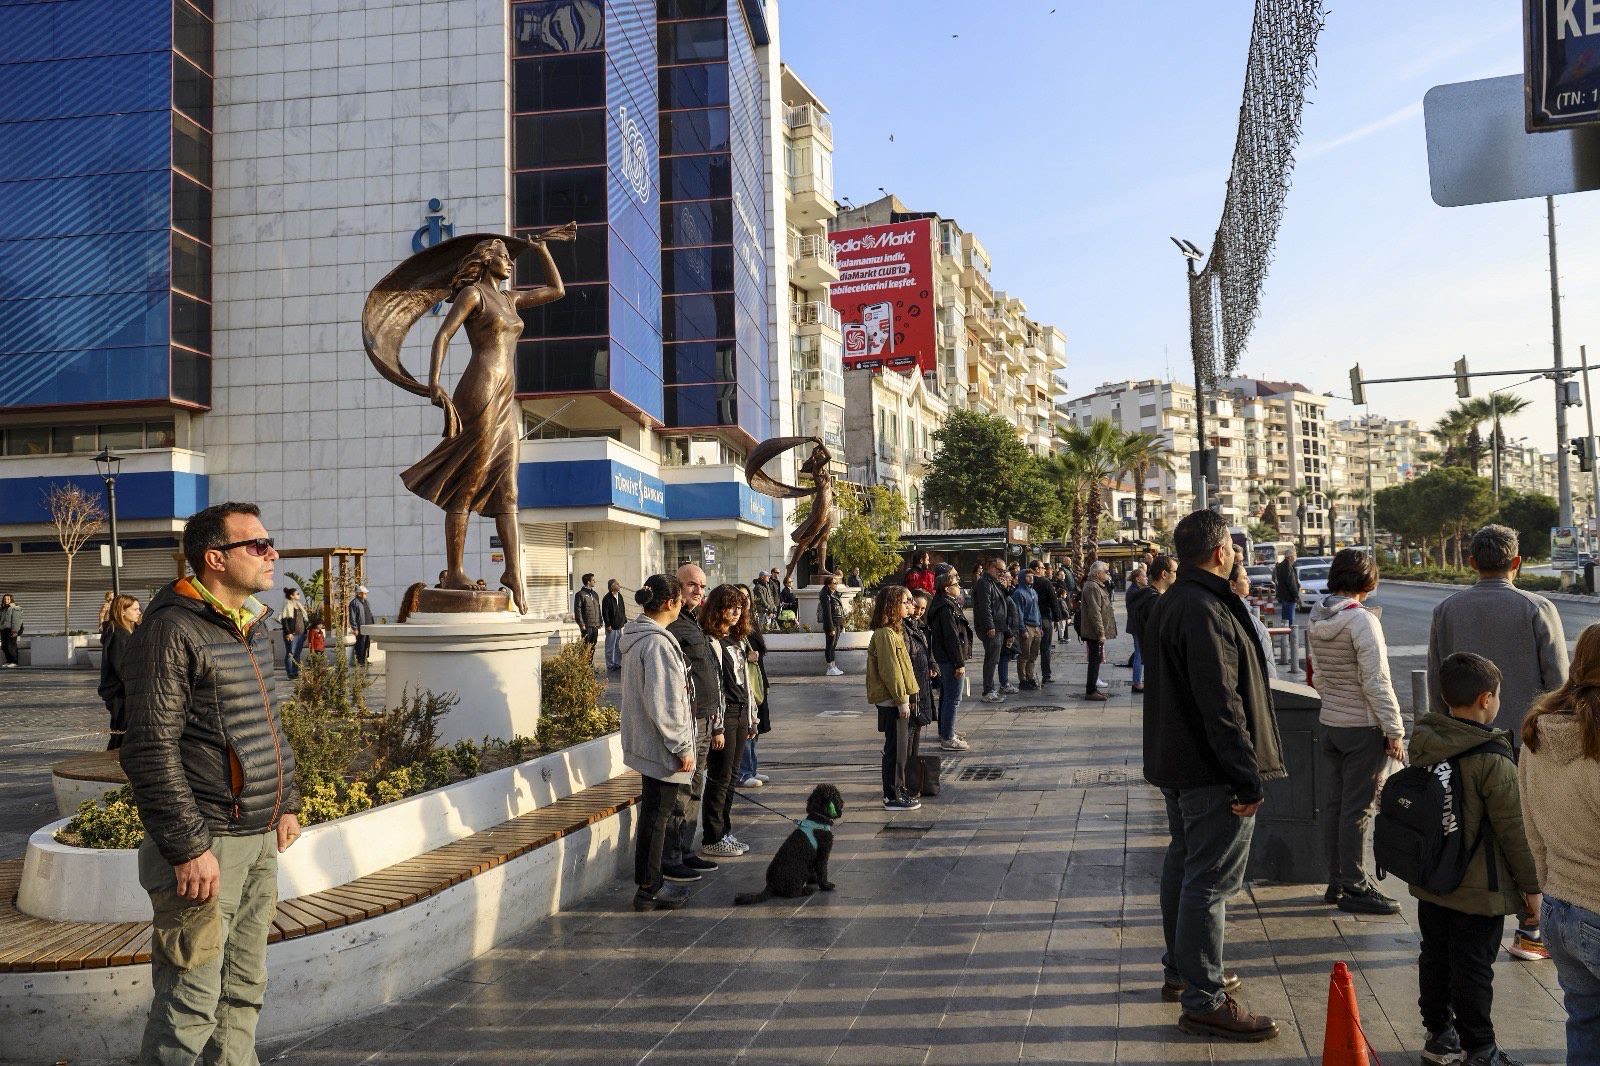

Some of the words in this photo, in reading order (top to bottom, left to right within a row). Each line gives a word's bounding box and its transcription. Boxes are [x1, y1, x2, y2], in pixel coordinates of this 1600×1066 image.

[1556, 91, 1586, 109] (TN:
[874, 230, 916, 248] Markt
[836, 254, 883, 269] gulamamızı
[840, 268, 877, 281] diaMarkt
[878, 265, 906, 276] CLUB'la
[614, 472, 639, 496] TÜRKİYE
[643, 485, 664, 504] BANKASI
